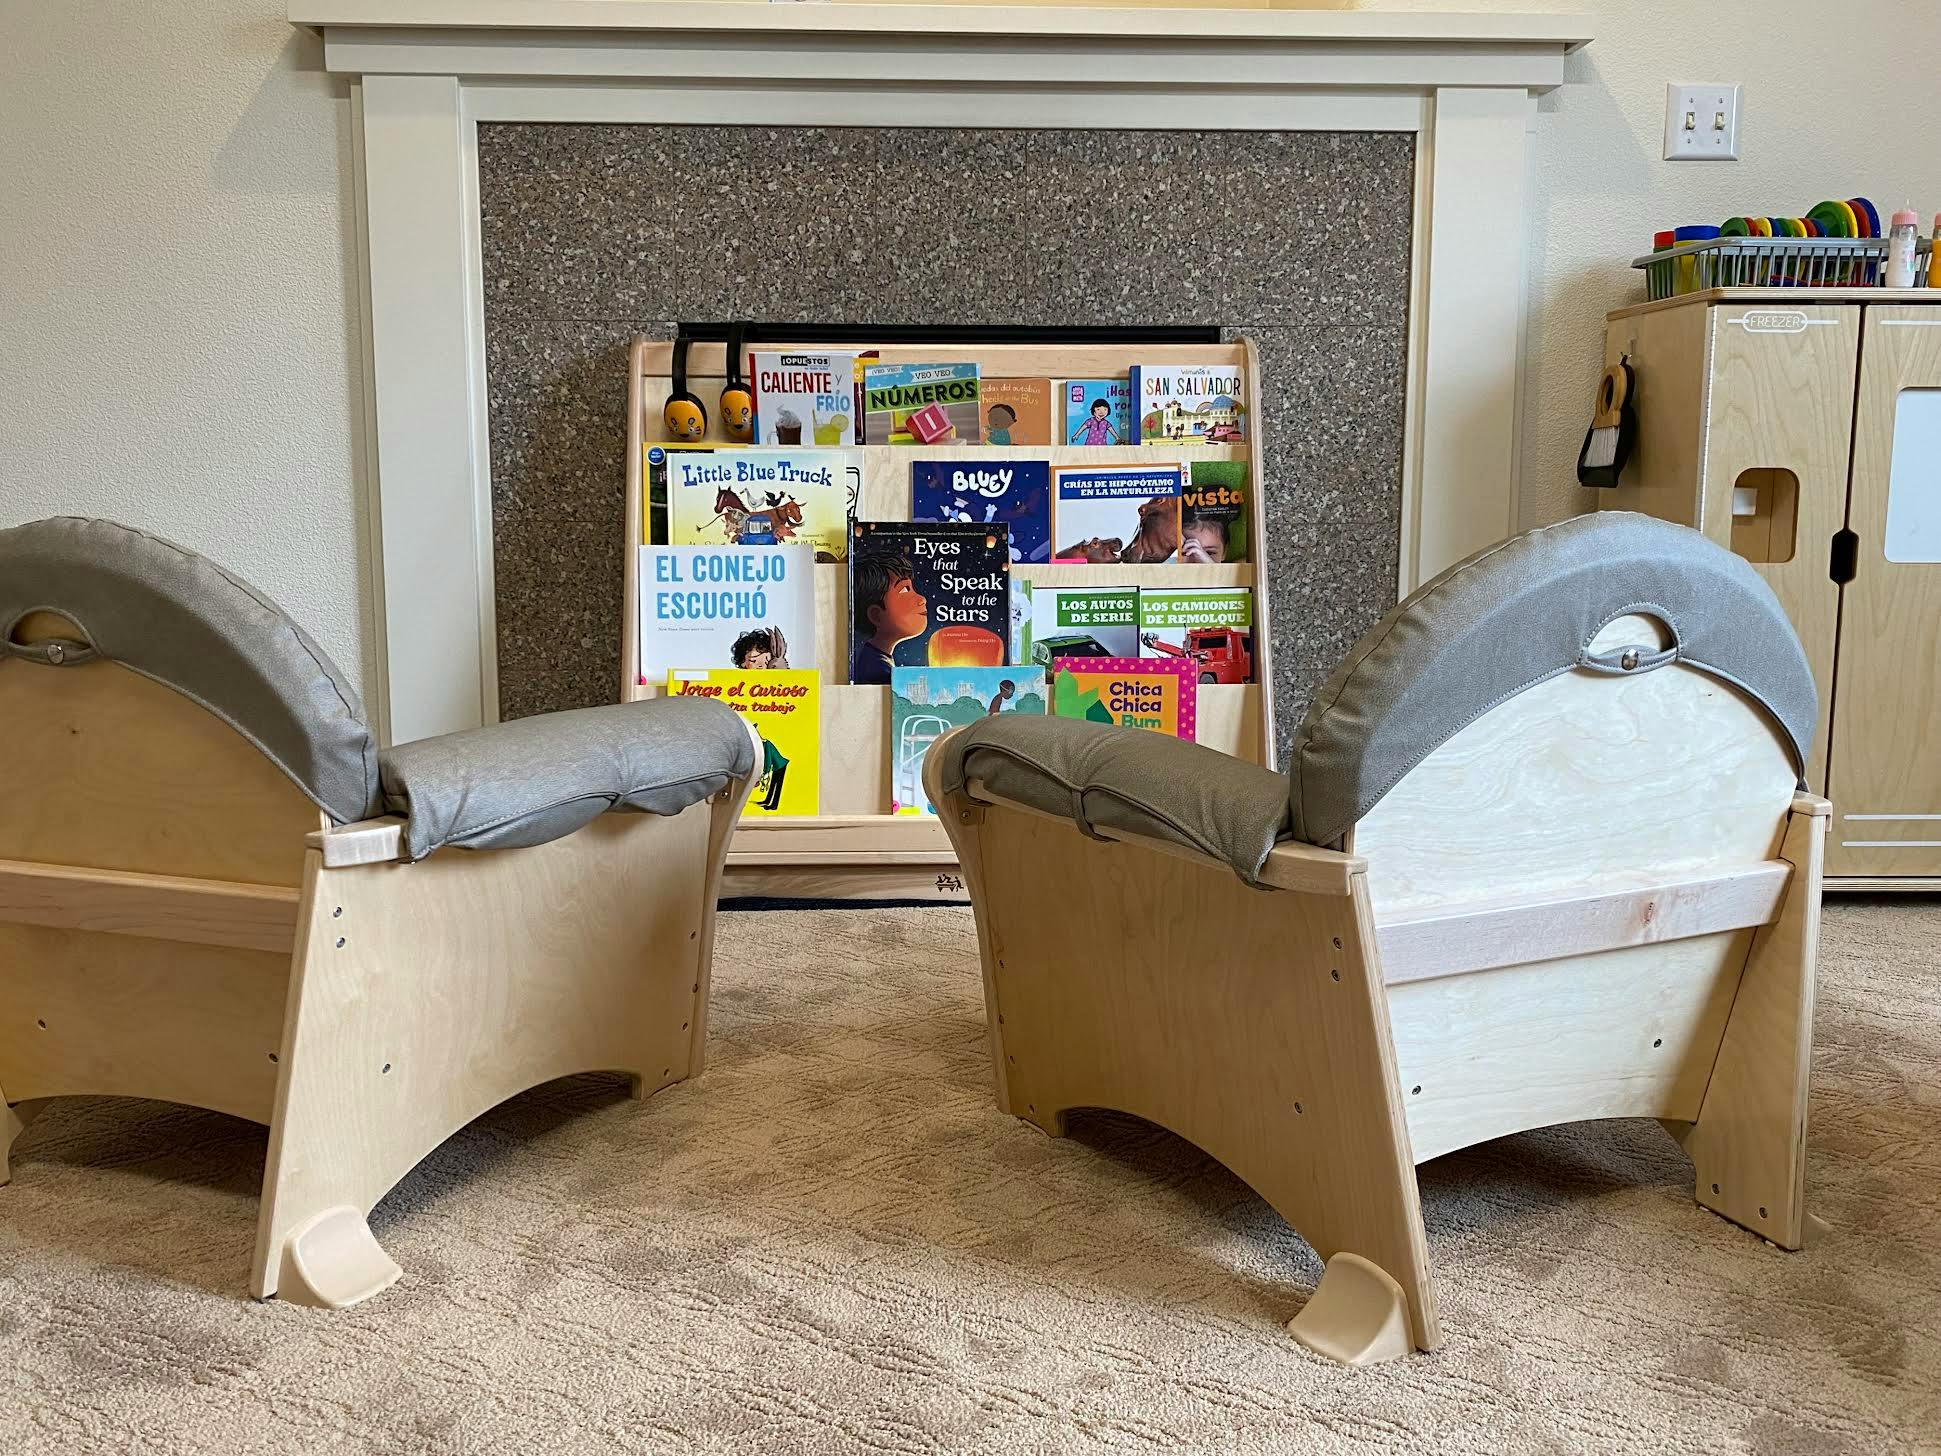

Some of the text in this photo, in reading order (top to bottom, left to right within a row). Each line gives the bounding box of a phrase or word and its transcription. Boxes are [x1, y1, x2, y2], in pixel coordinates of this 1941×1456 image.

[1750, 315, 1800, 328] FREEZER
[915, 369, 951, 380] VEO VEO
[761, 371, 832, 394] CALIENTE
[1146, 377, 1241, 396] SAN SALVADOR
[816, 389, 850, 412] FRÍO
[871, 381, 977, 409] NÚMEROS
[682, 463, 732, 487] Little
[736, 461, 776, 482] Blue
[777, 461, 833, 487] Truck
[1063, 480, 1092, 489] CRÍAS
[1094, 480, 1107, 488] DE
[1109, 477, 1174, 488] HIPOPÓTAMO
[1110, 486, 1174, 496] NATURALEZA
[1183, 487, 1244, 507] vista
[914, 538, 960, 559] Eyes
[656, 555, 786, 582] EL CONEJO
[933, 558, 958, 570] that
[941, 573, 1003, 594] Speak
[657, 585, 767, 619] ESCUCHÓ
[962, 593, 997, 606] to the
[1061, 599, 1133, 610] LOS AUTOS
[1143, 600, 1245, 611] LOS CAMIONES
[936, 605, 989, 622] Stars
[1071, 612, 1133, 622] DE SERIE
[1146, 612, 1245, 624] DE REMOLQUE
[727, 681, 745, 697] el
[749, 684, 809, 698] Curioso
[1109, 681, 1162, 696] Chica
[751, 702, 796, 714] trabajo
[1109, 697, 1162, 713] Chica
[1121, 714, 1162, 729] Bum
